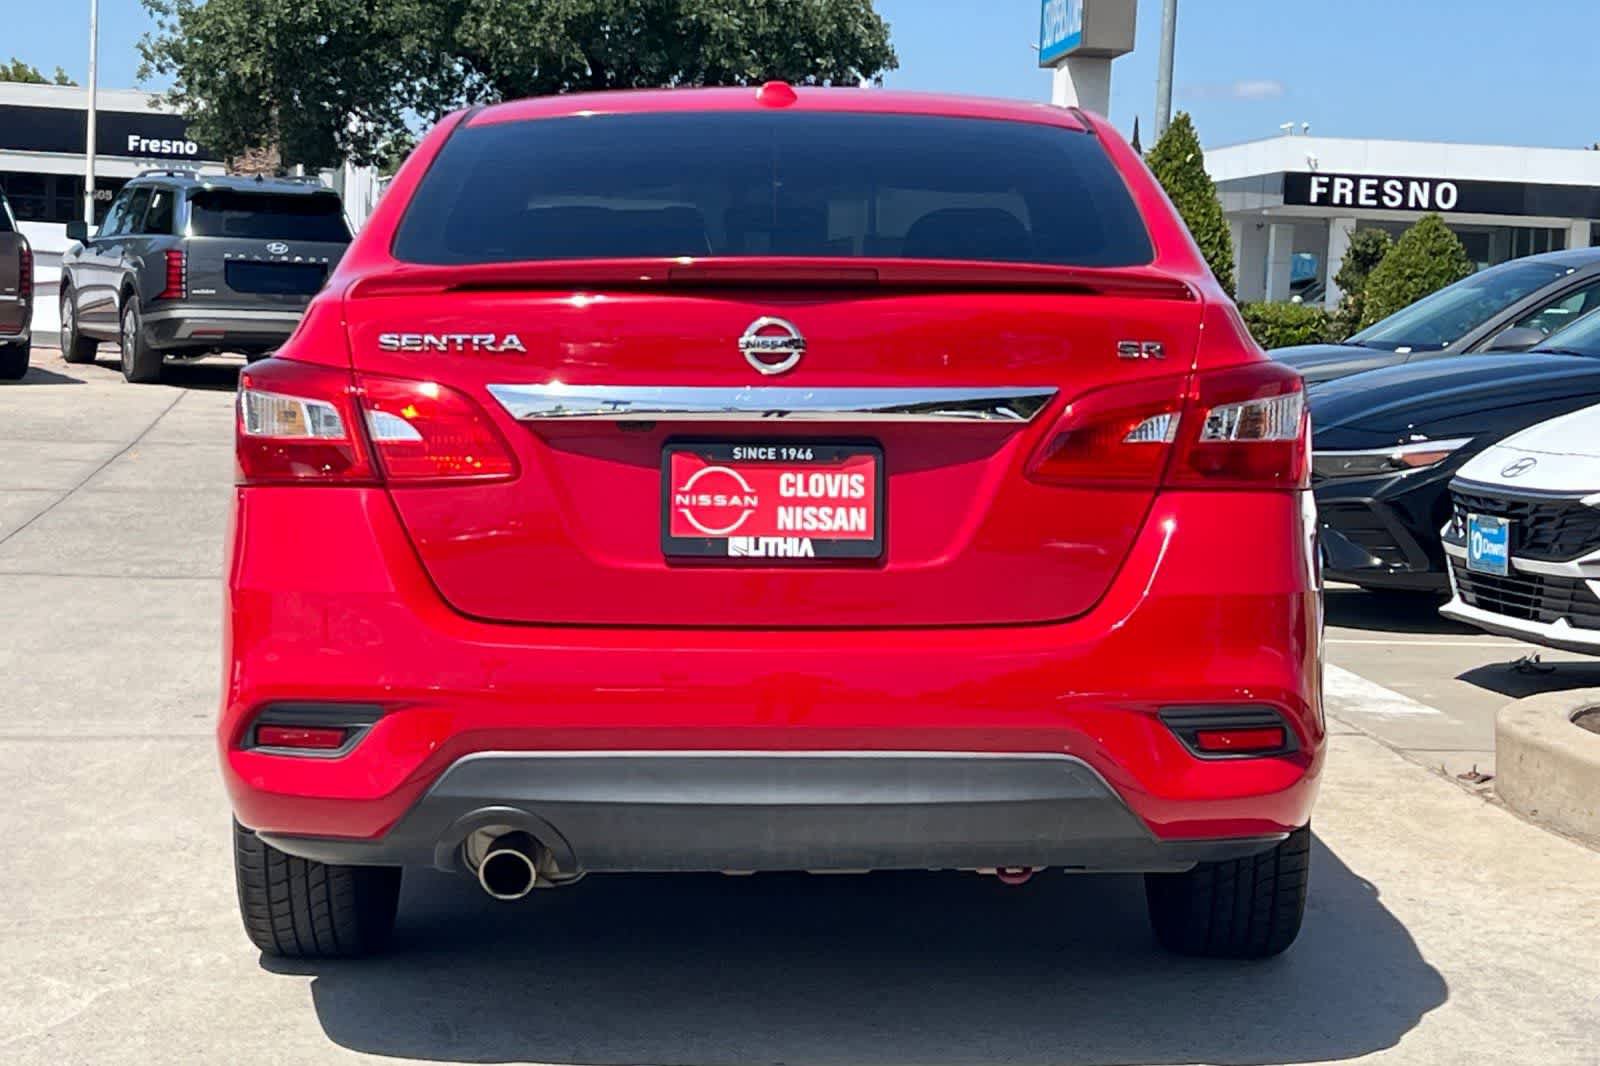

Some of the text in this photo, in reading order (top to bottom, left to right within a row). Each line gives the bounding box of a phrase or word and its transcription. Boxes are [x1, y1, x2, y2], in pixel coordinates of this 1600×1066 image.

[128, 135, 197, 154] Fresno
[1309, 176, 1457, 210] FRESNO
[378, 333, 527, 352] SENTRA
[742, 338, 804, 350] NISSAN
[1117, 341, 1166, 358] SR
[733, 447, 813, 460] SINCE 1946
[780, 473, 864, 498] CLOVIS
[675, 494, 758, 506] NISSAN
[777, 506, 867, 531] NISSAN
